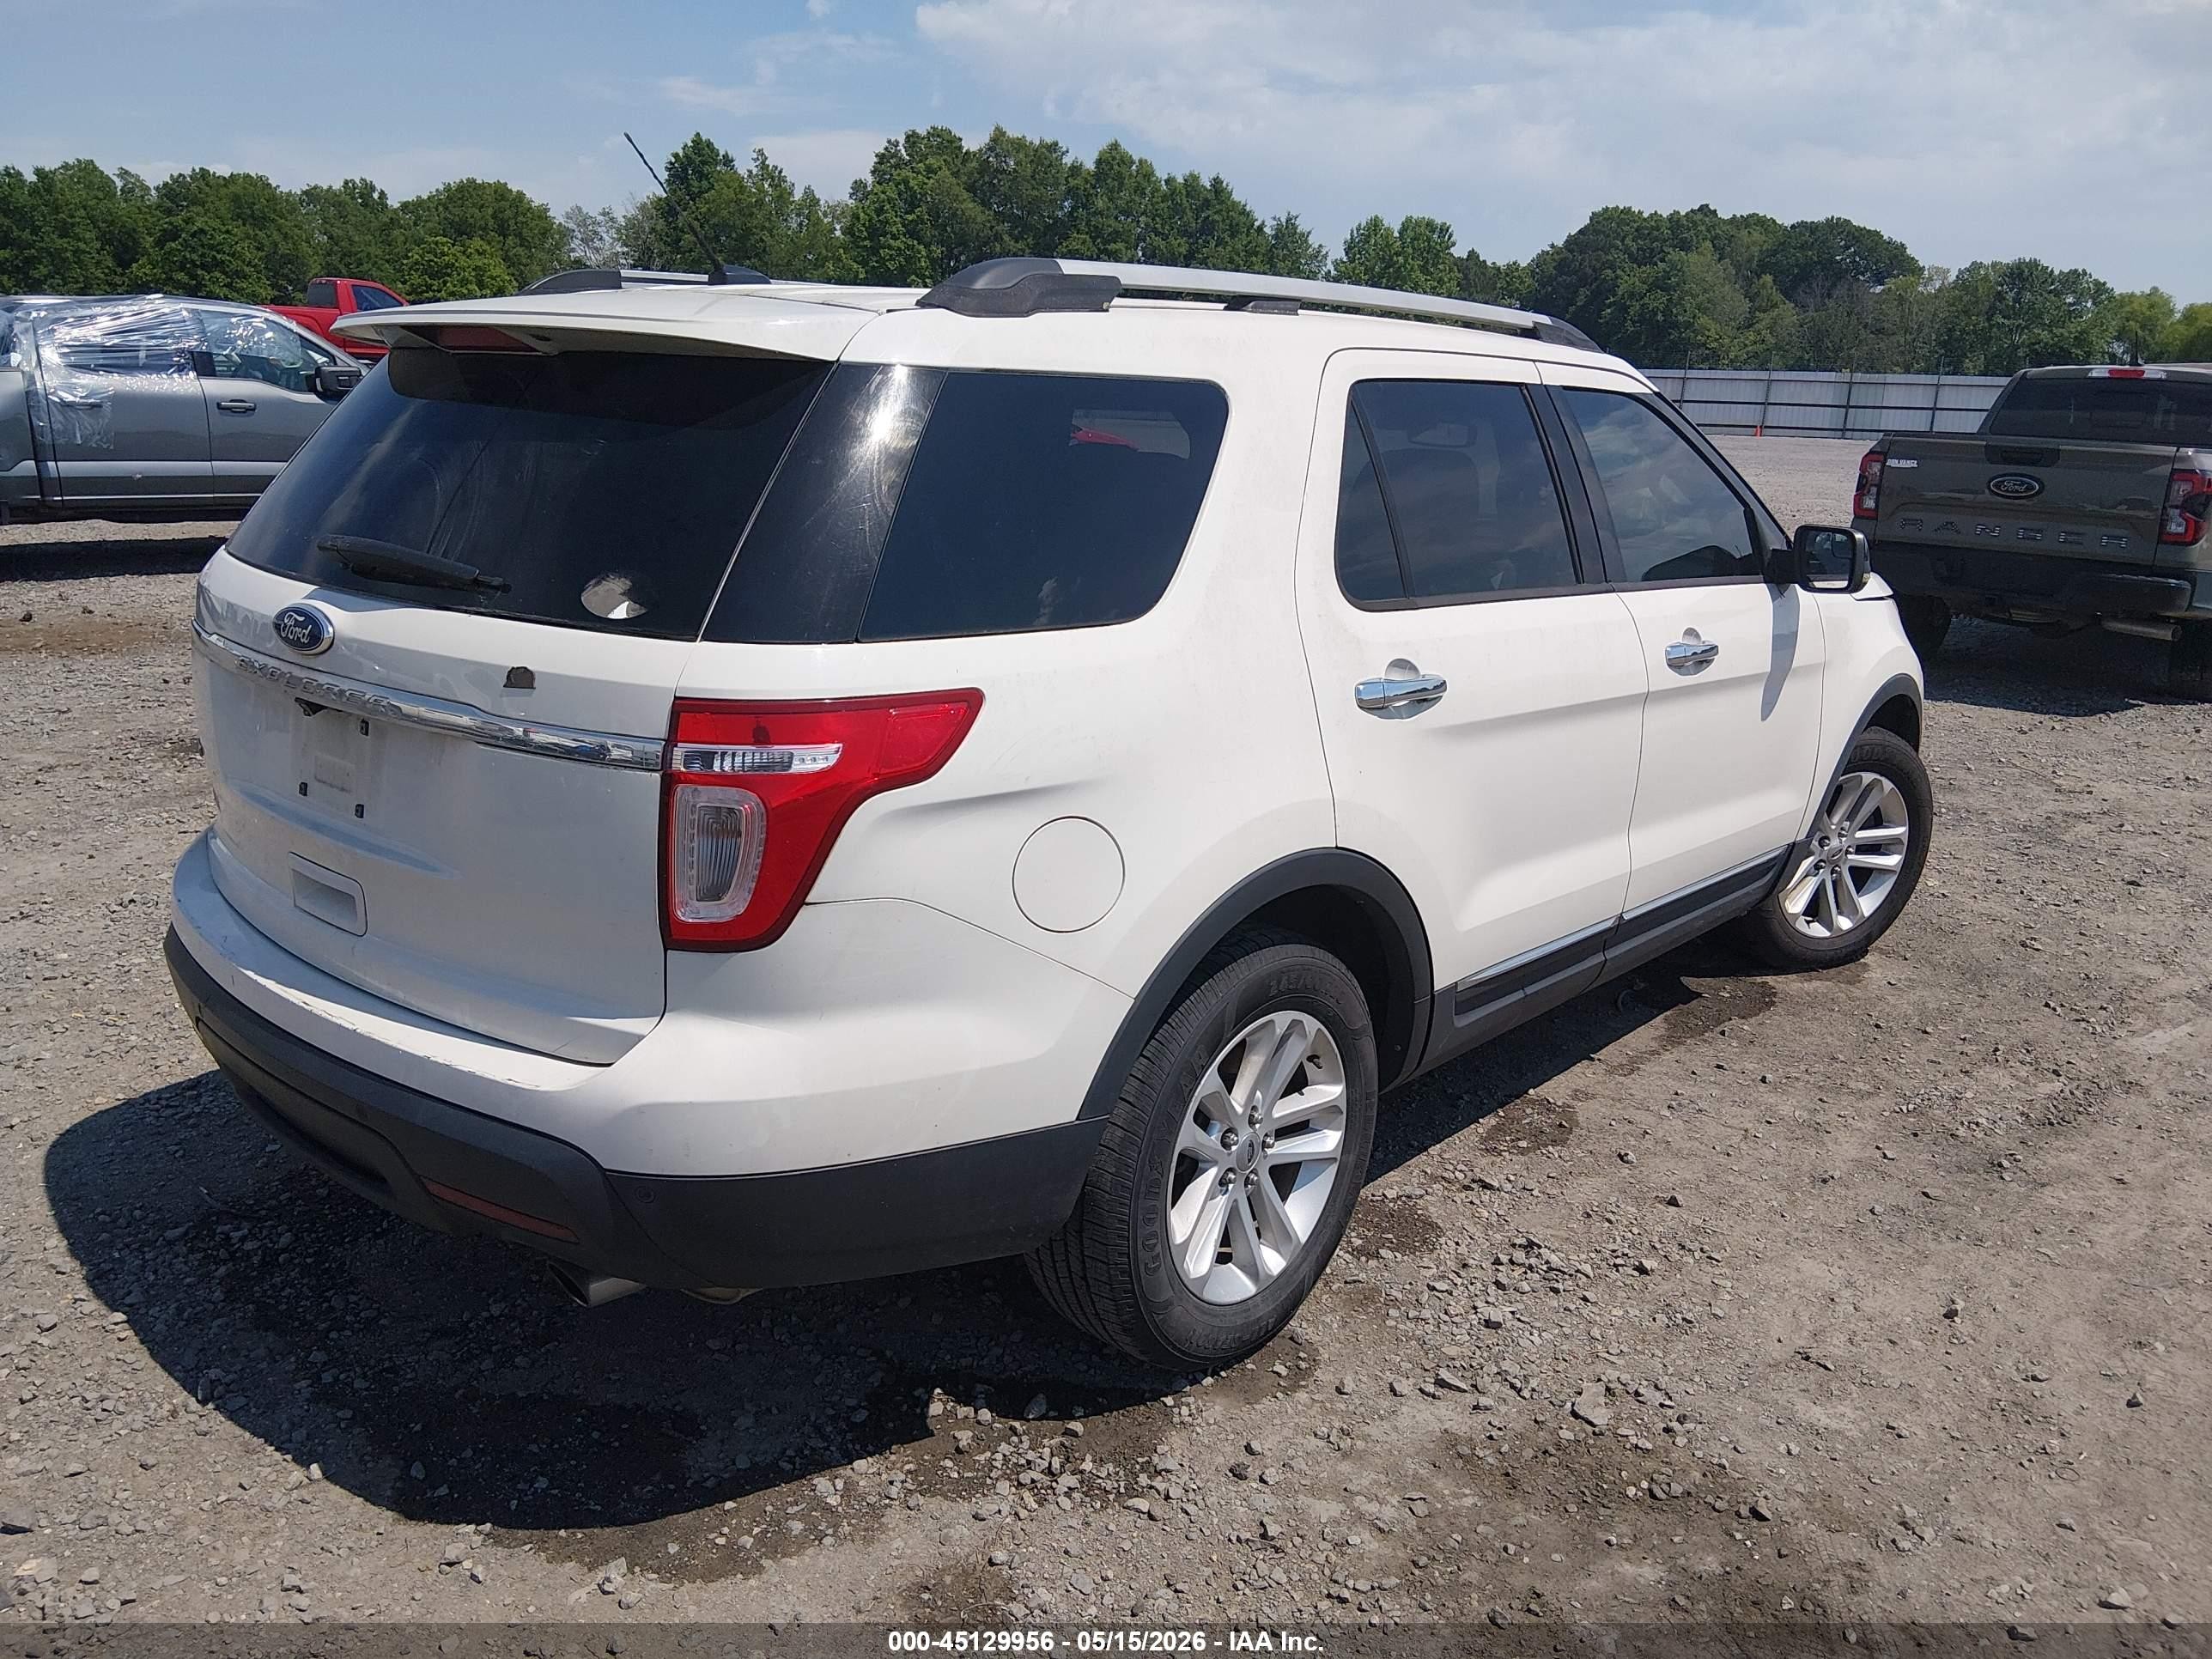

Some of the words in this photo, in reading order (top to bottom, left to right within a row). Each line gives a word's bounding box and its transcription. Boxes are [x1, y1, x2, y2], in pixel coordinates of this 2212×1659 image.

[1899, 519, 2129, 549] RANGER
[280, 611, 313, 644] Ford
[234, 655, 404, 717] EXPLORER
